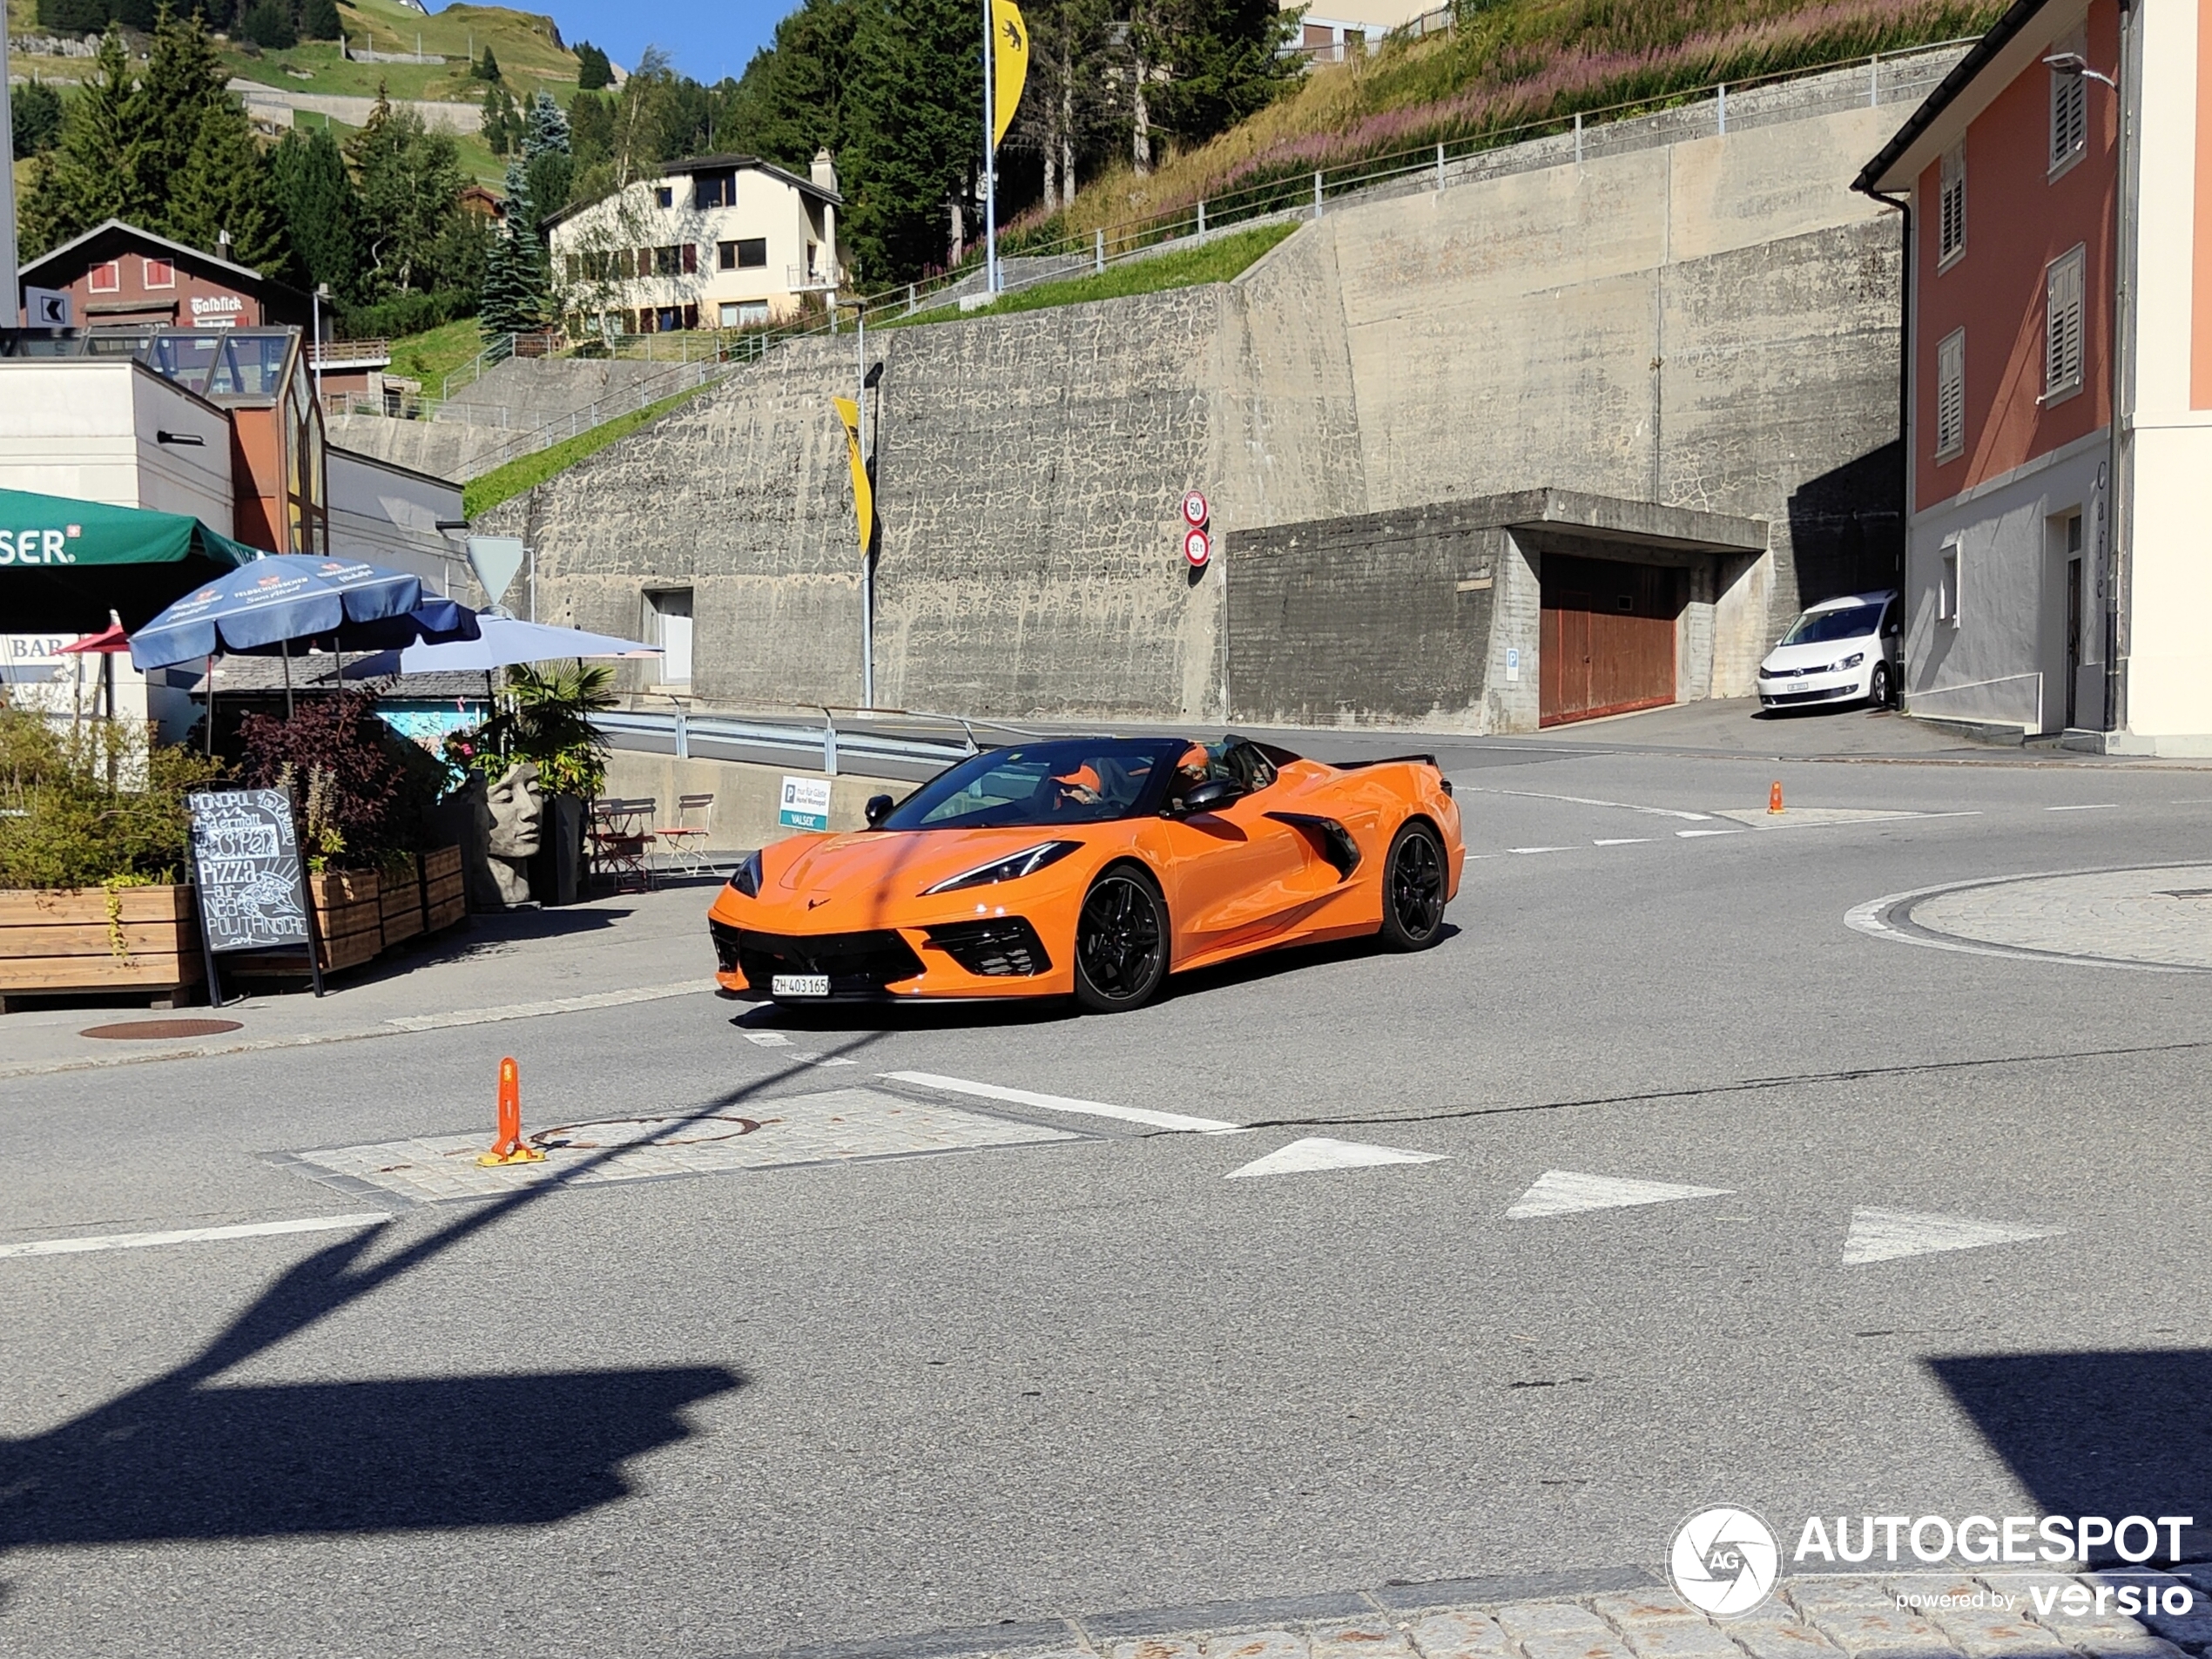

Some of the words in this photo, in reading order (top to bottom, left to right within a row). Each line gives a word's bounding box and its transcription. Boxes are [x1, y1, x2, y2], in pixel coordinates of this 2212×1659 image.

[190, 296, 243, 314] Talblick
[1190, 502, 1200, 515] 50
[2096, 461, 2106, 599] Café
[12, 638, 66, 658] BAR
[189, 792, 254, 810] MONOPOL
[813, 789, 826, 798] Gäste
[808, 799, 826, 807] Monopol
[192, 813, 262, 833] Andermatt
[791, 814, 814, 827] VALSER
[809, 979, 826, 993] 165
